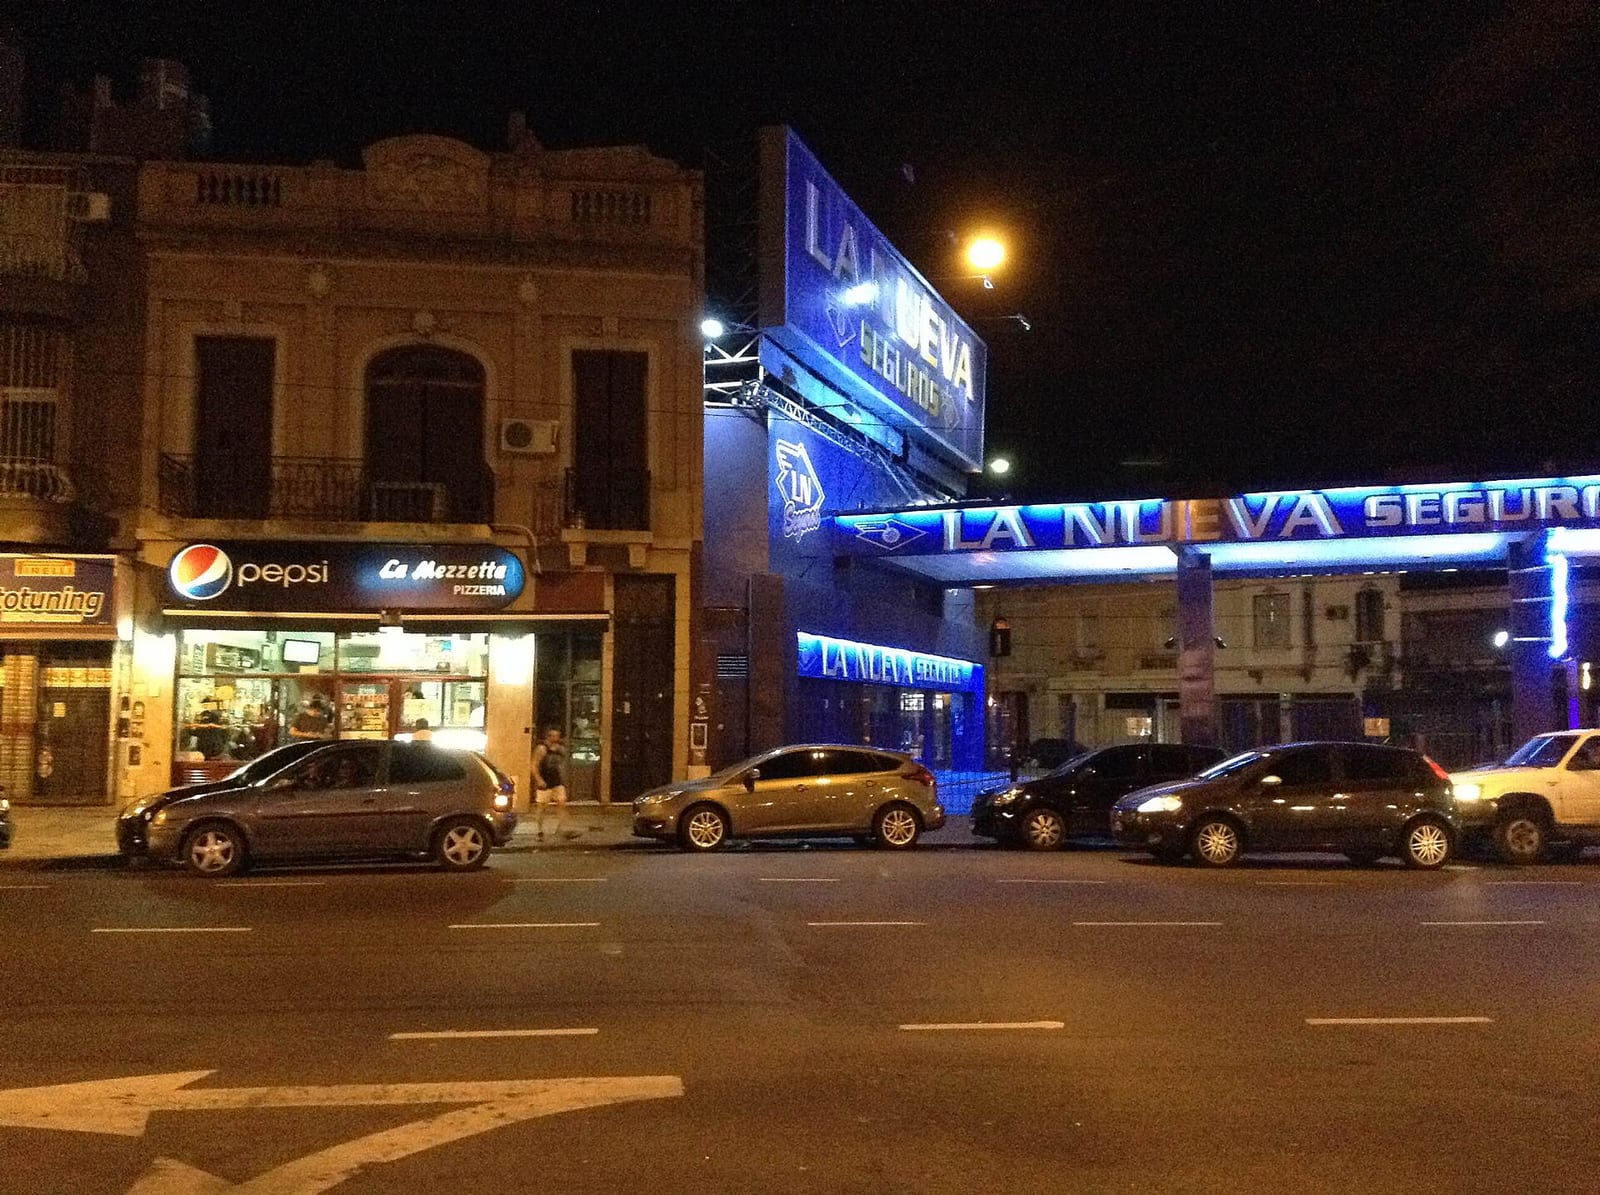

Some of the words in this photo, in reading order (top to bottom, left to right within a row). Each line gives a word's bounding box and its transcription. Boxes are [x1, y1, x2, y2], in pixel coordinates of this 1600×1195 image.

[805, 179, 860, 285] LA
[860, 319, 939, 416] SEGUROS
[791, 470, 812, 506] LN
[942, 509, 1037, 551] LA
[1063, 490, 1343, 545] NUEVA
[237, 560, 329, 588] pepsi
[378, 558, 409, 580] La
[411, 560, 508, 581] Mezzetta
[453, 584, 506, 597] PIZZERIA
[821, 640, 848, 678] LA
[855, 645, 914, 684] NUEVA
